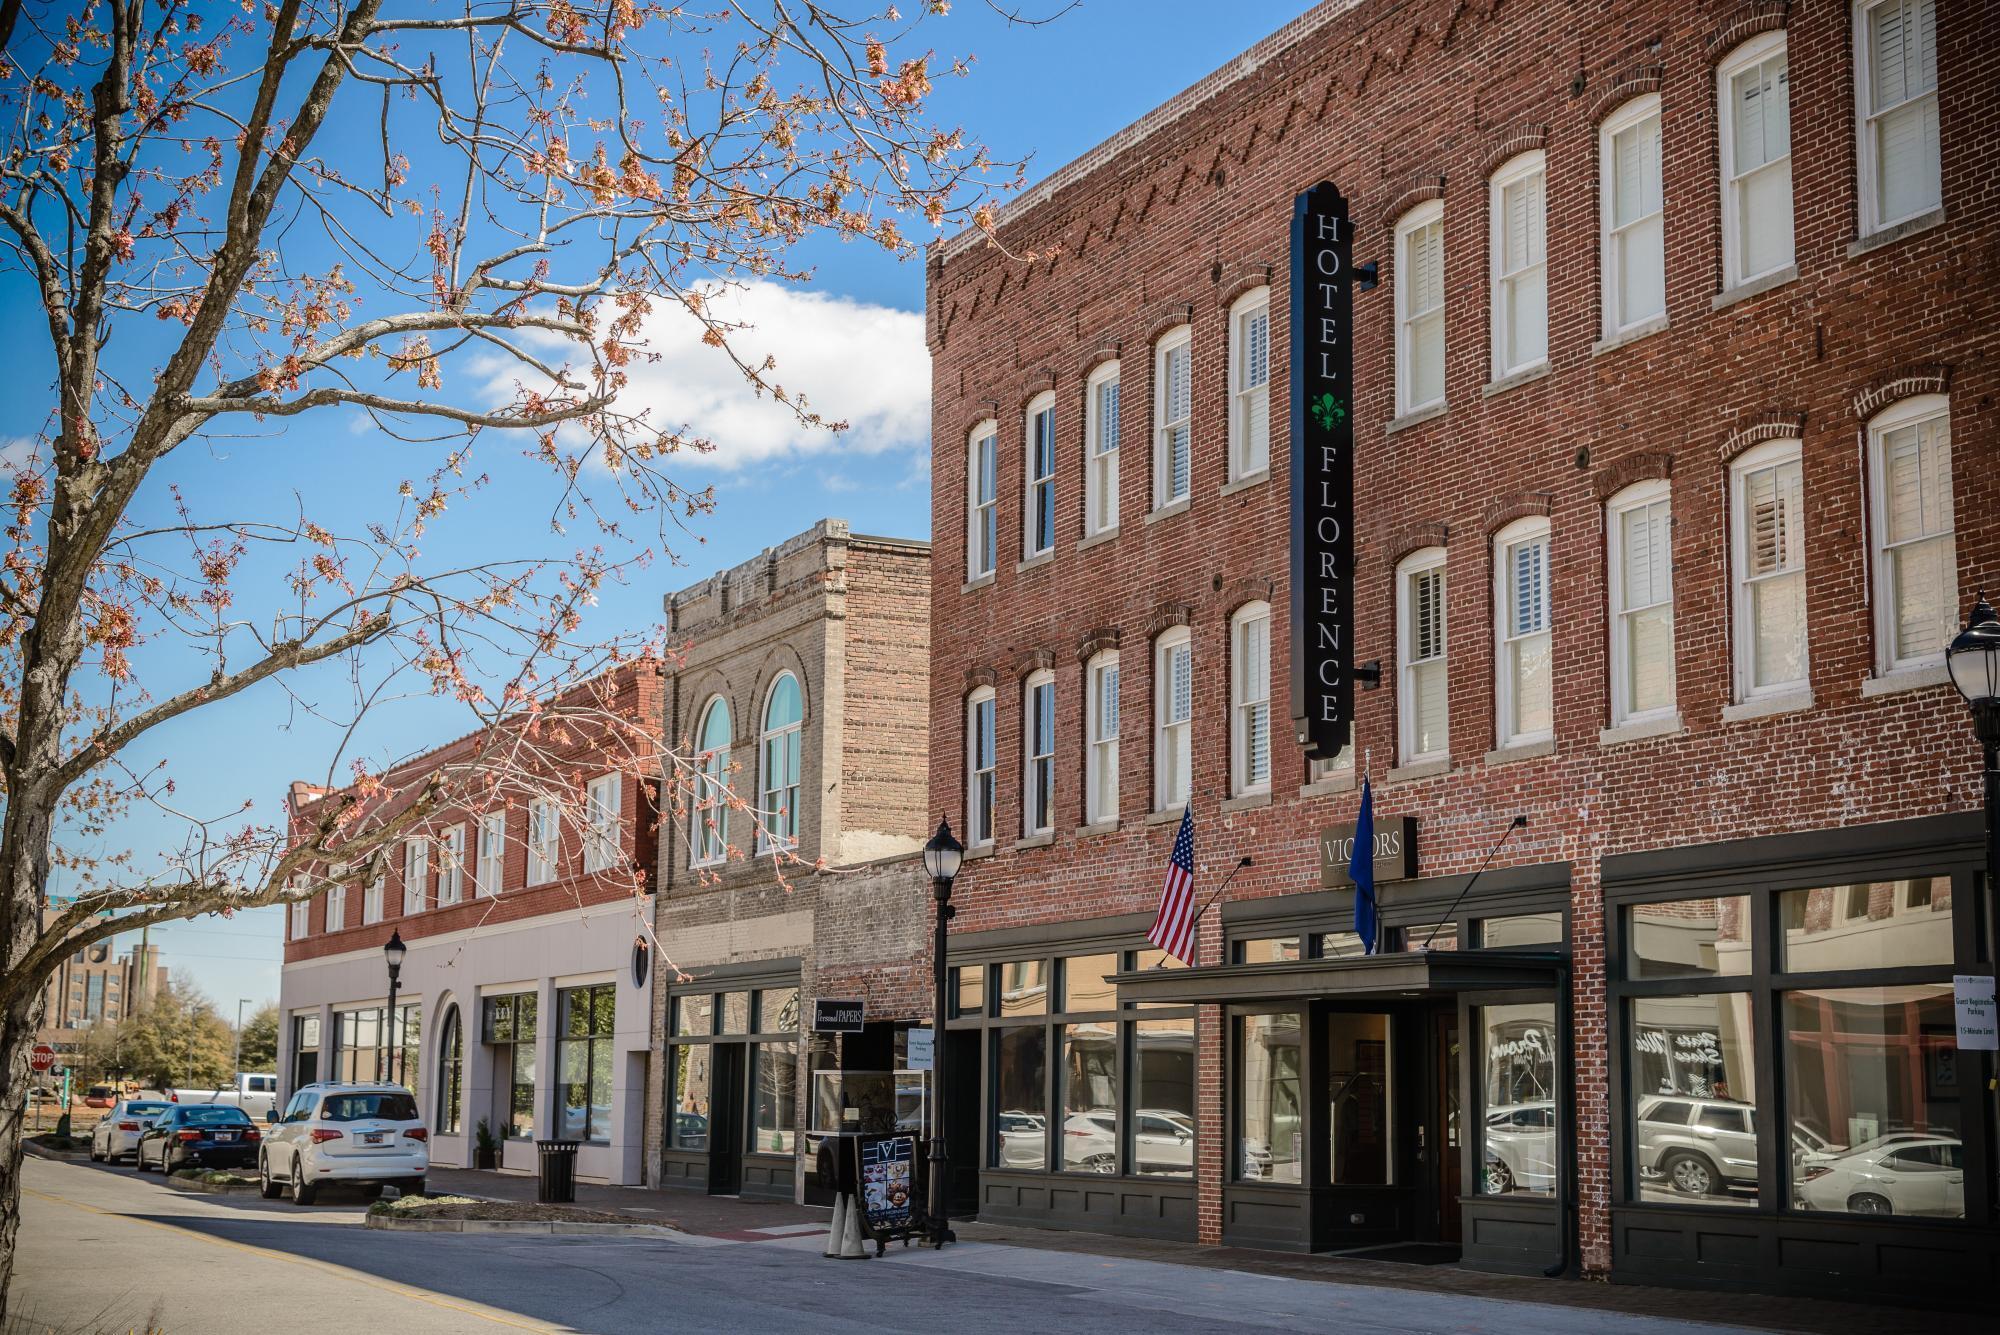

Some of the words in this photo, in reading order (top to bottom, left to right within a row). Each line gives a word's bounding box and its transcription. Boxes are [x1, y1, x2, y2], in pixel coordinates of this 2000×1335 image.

[1316, 213, 1340, 380] HOTEL
[1317, 446, 1341, 722] FLORENCE
[1325, 830, 1400, 862] VICORS
[817, 1010, 839, 1022] Personal
[839, 1010, 862, 1023] PAPERS
[1968, 1008, 1984, 1016] Parking
[31, 1053, 54, 1063] STOP
[880, 1142, 894, 1159] V
